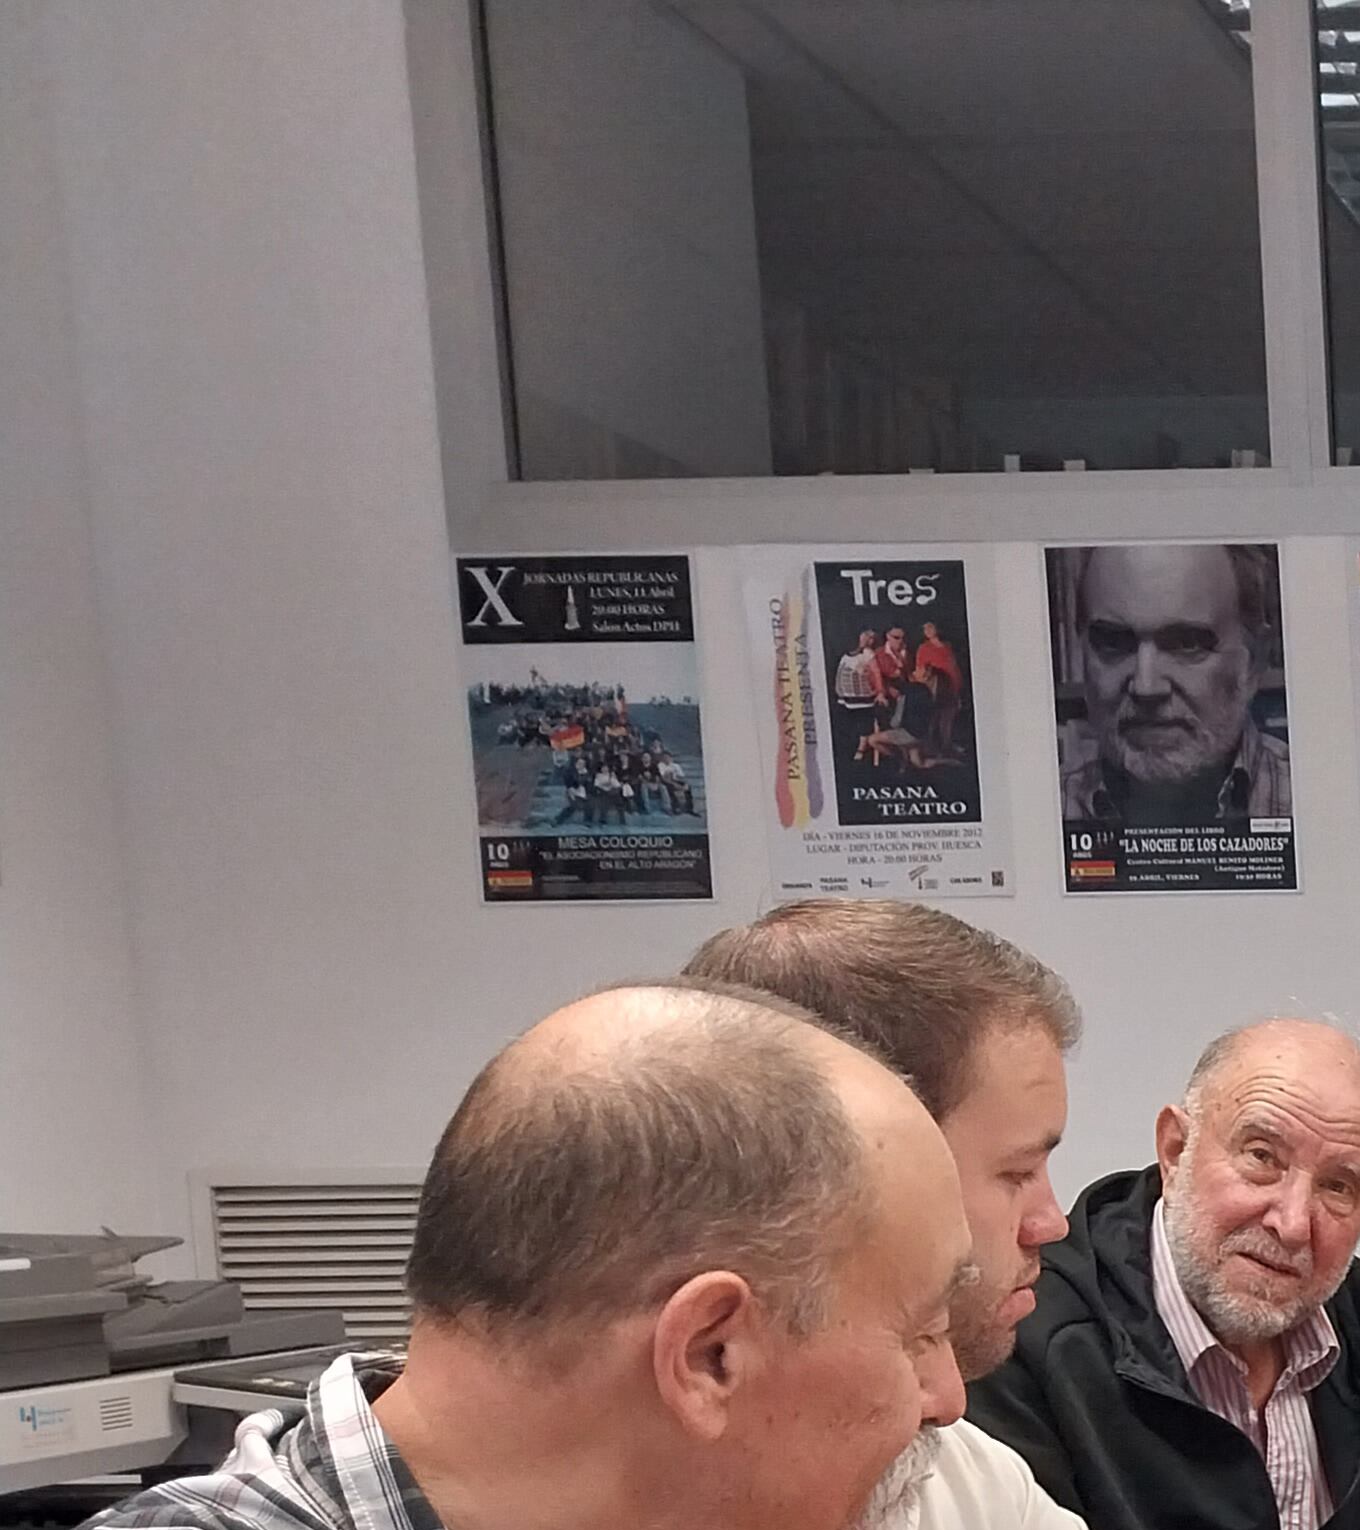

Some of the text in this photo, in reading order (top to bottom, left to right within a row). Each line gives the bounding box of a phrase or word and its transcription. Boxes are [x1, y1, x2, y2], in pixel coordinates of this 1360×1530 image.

[523, 572, 678, 586] JORNADAS REPUBLICANAS
[840, 569, 940, 606] Tres
[465, 566, 524, 626] X
[769, 598, 800, 780] PASANA TEATRO
[794, 634, 817, 744] PRESENTA
[853, 786, 937, 799] PASANA
[878, 801, 967, 816] TEATRO
[558, 836, 673, 849] MESA COLOQUIO
[1070, 834, 1092, 851] 10
[1142, 839, 1177, 853] NOCHE
[1181, 839, 1195, 852] DE
[1197, 838, 1216, 852] LOS
[1219, 838, 1289, 852] CAZADORES"
[488, 843, 510, 861] 10
